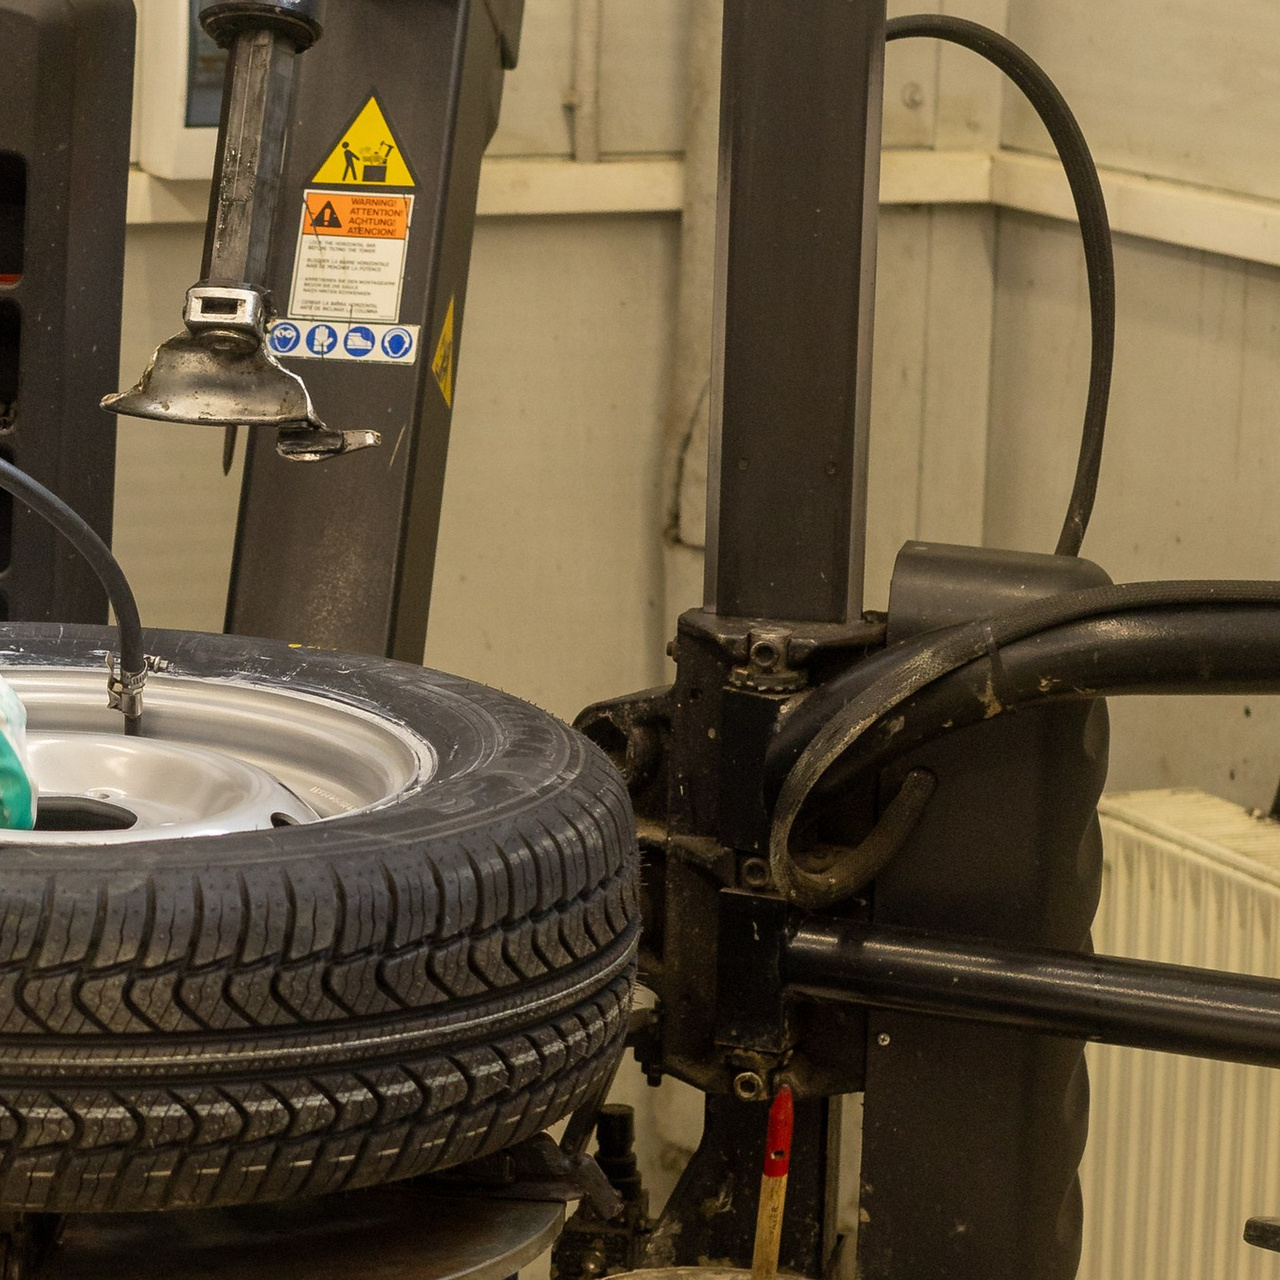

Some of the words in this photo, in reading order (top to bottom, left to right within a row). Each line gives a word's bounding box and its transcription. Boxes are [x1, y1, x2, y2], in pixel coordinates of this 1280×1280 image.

[351, 198, 397, 207] WARNING!
[350, 208, 404, 217] ATTENTION!
[348, 217, 396, 226] ACHTUNG!
